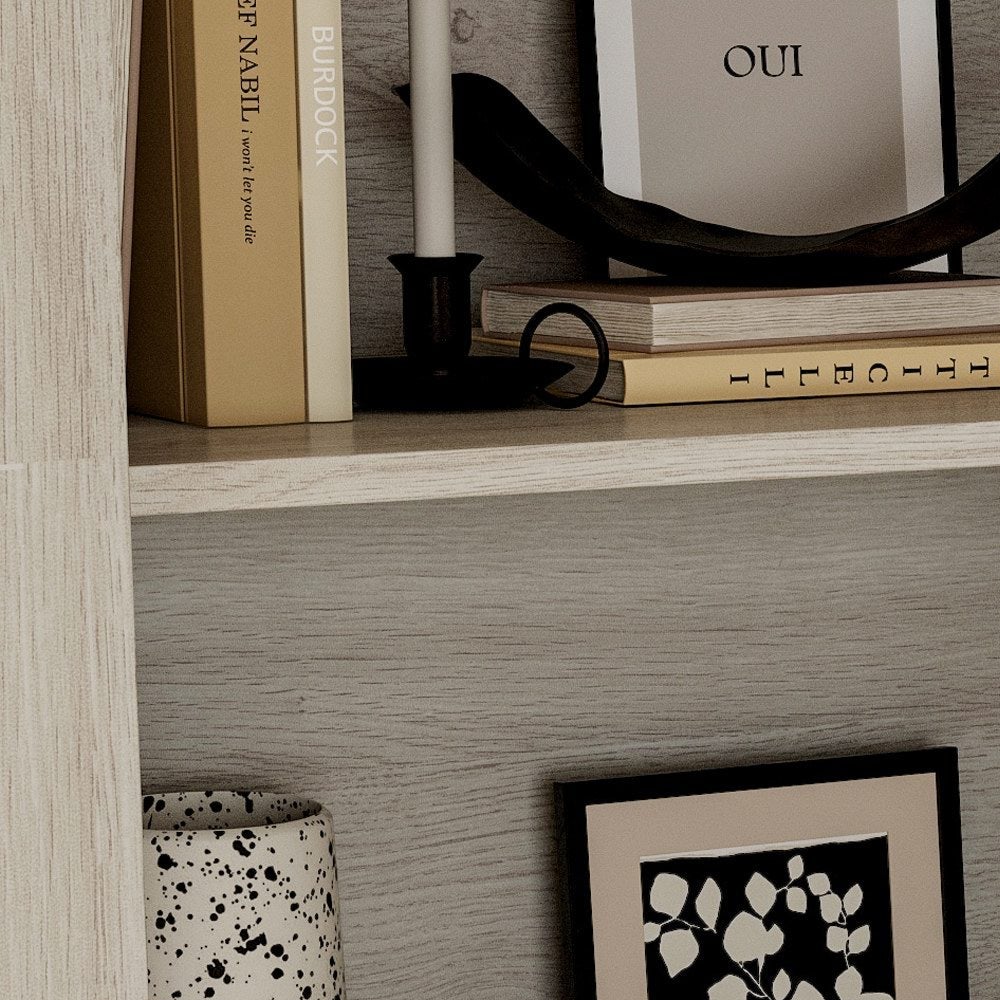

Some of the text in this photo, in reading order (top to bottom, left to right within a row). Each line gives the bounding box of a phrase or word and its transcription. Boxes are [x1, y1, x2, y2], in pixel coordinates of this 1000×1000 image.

[723, 44, 804, 78] OUI
[239, 35, 260, 122] NABIL
[312, 26, 338, 167] BURDOCK
[242, 137, 255, 172] won't
[243, 176, 255, 194] let
[240, 197, 253, 221] you
[244, 224, 257, 245] die
